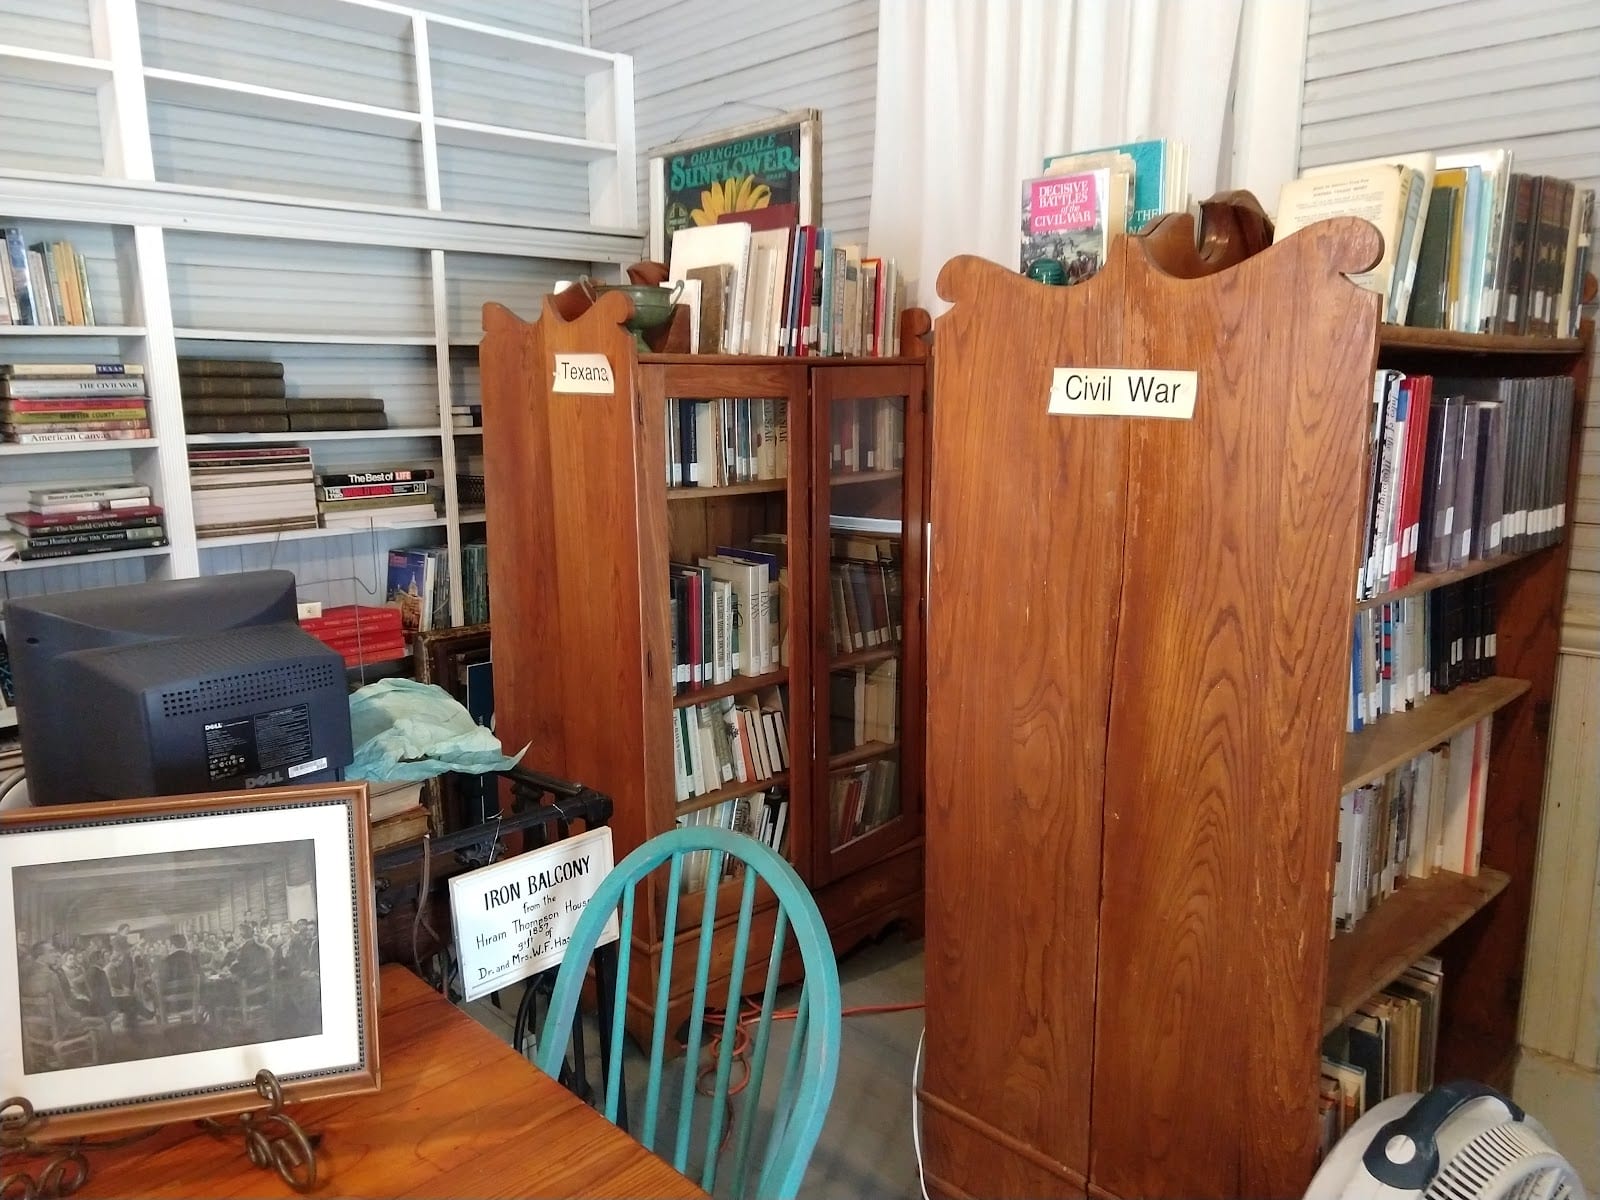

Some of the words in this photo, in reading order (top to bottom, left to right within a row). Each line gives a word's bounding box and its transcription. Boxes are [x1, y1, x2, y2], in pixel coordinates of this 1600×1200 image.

[690, 134, 776, 166] ORANGEDALE
[670, 146, 799, 191] SUNFLOWER
[1039, 180, 1089, 197] DECISIVE
[1039, 191, 1088, 208] BATTLES
[1061, 206, 1069, 215] of
[1069, 203, 1080, 213] the
[1034, 213, 1066, 227] CIVIL
[1067, 210, 1091, 224] WAR
[561, 362, 608, 381] Texana
[1065, 374, 1112, 401] Civil
[1128, 376, 1181, 403] War
[31, 433, 76, 442] American
[348, 474, 365, 484] The
[365, 473, 384, 482] Best
[385, 472, 393, 480] of
[395, 471, 411, 480] LIFE
[751, 593, 759, 619] TEXAS
[760, 591, 769, 617] TEXAS
[204, 722, 222, 731] DELL
[245, 771, 284, 789] DELL
[484, 882, 521, 910] IRON
[528, 855, 590, 896] BALCONY
[523, 901, 540, 914] from
[543, 894, 556, 906] the
[476, 931, 507, 949] Hiram
[512, 911, 559, 934] Thompson
[518, 937, 534, 951] gift
[545, 927, 553, 938] of
[529, 923, 549, 937] 1857
[478, 967, 495, 980] Dr.
[496, 961, 510, 973] and
